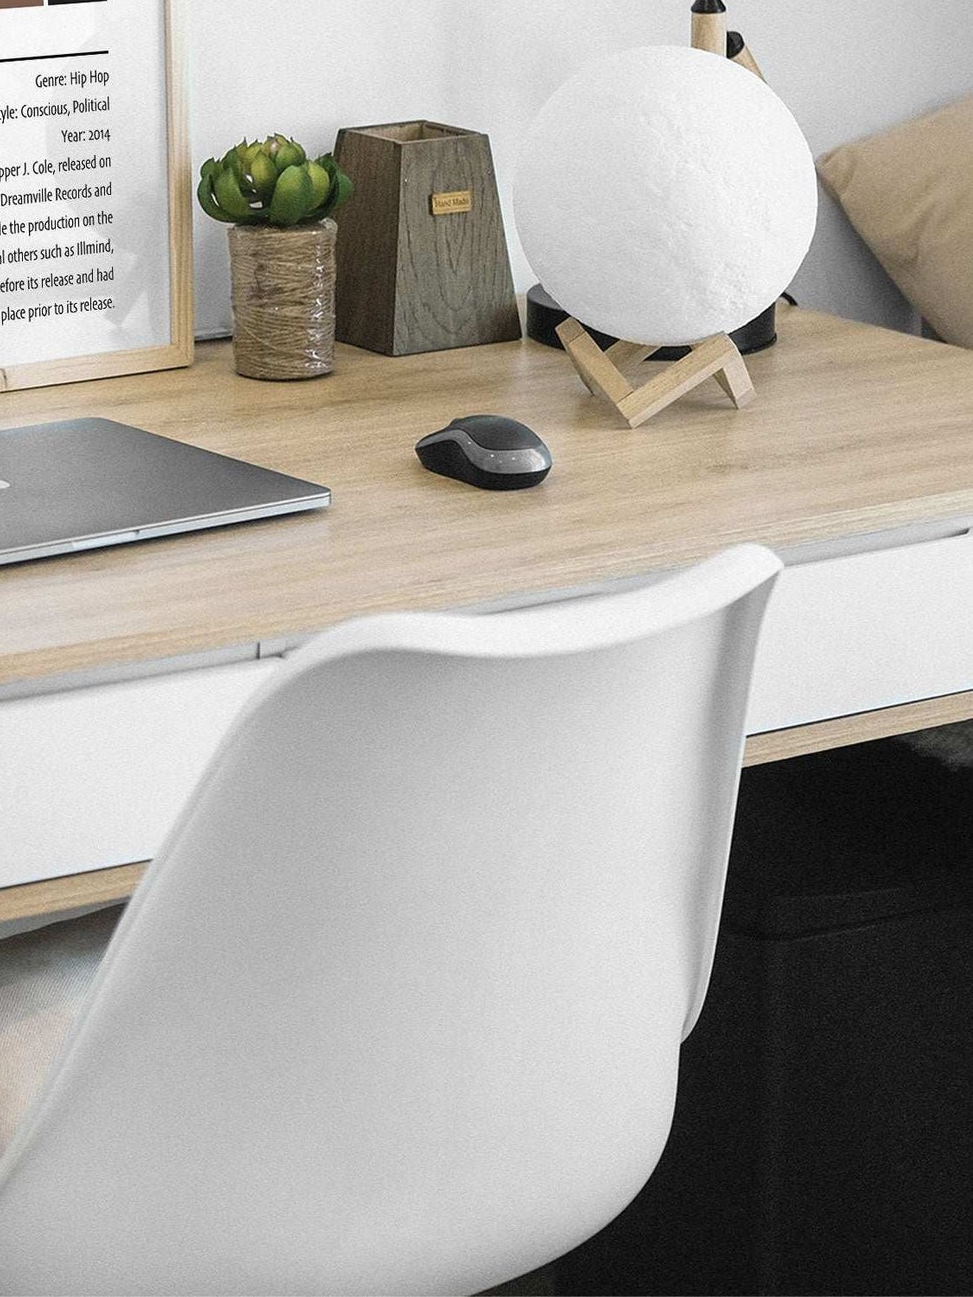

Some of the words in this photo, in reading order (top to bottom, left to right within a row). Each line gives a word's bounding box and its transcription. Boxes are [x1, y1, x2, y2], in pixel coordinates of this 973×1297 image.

[35, 74, 67, 88] Genre:
[70, 71, 87, 88] Hip
[90, 70, 109, 86] Hop
[21, 102, 70, 118] Conscious,
[73, 96, 110, 113] Political
[61, 130, 86, 143] Year:
[88, 129, 111, 141] 2014
[23, 162, 30, 176] J.
[32, 159, 56, 175] Cole,
[58, 155, 97, 172] released
[99, 157, 111, 168] on
[0, 188, 53, 207] Dreamville
[55, 184, 92, 201] Records
[94, 181, 112, 197] and
[9, 220, 26, 234] the
[28, 215, 80, 236] production
[83, 215, 95, 227] on
[97, 210, 113, 225] the
[7, 248, 38, 263] others
[40, 244, 62, 260] such
[64, 246, 75, 258] as
[77, 238, 114, 256] Illmind,
[27, 276, 39, 290] its
[41, 273, 74, 288] release
[76, 268, 94, 285] and
[97, 266, 114, 282] had
[1, 306, 26, 326] place
[28, 303, 52, 322] prior
[54, 303, 64, 315] to
[67, 300, 78, 313] its
[80, 297, 115, 312] release.
